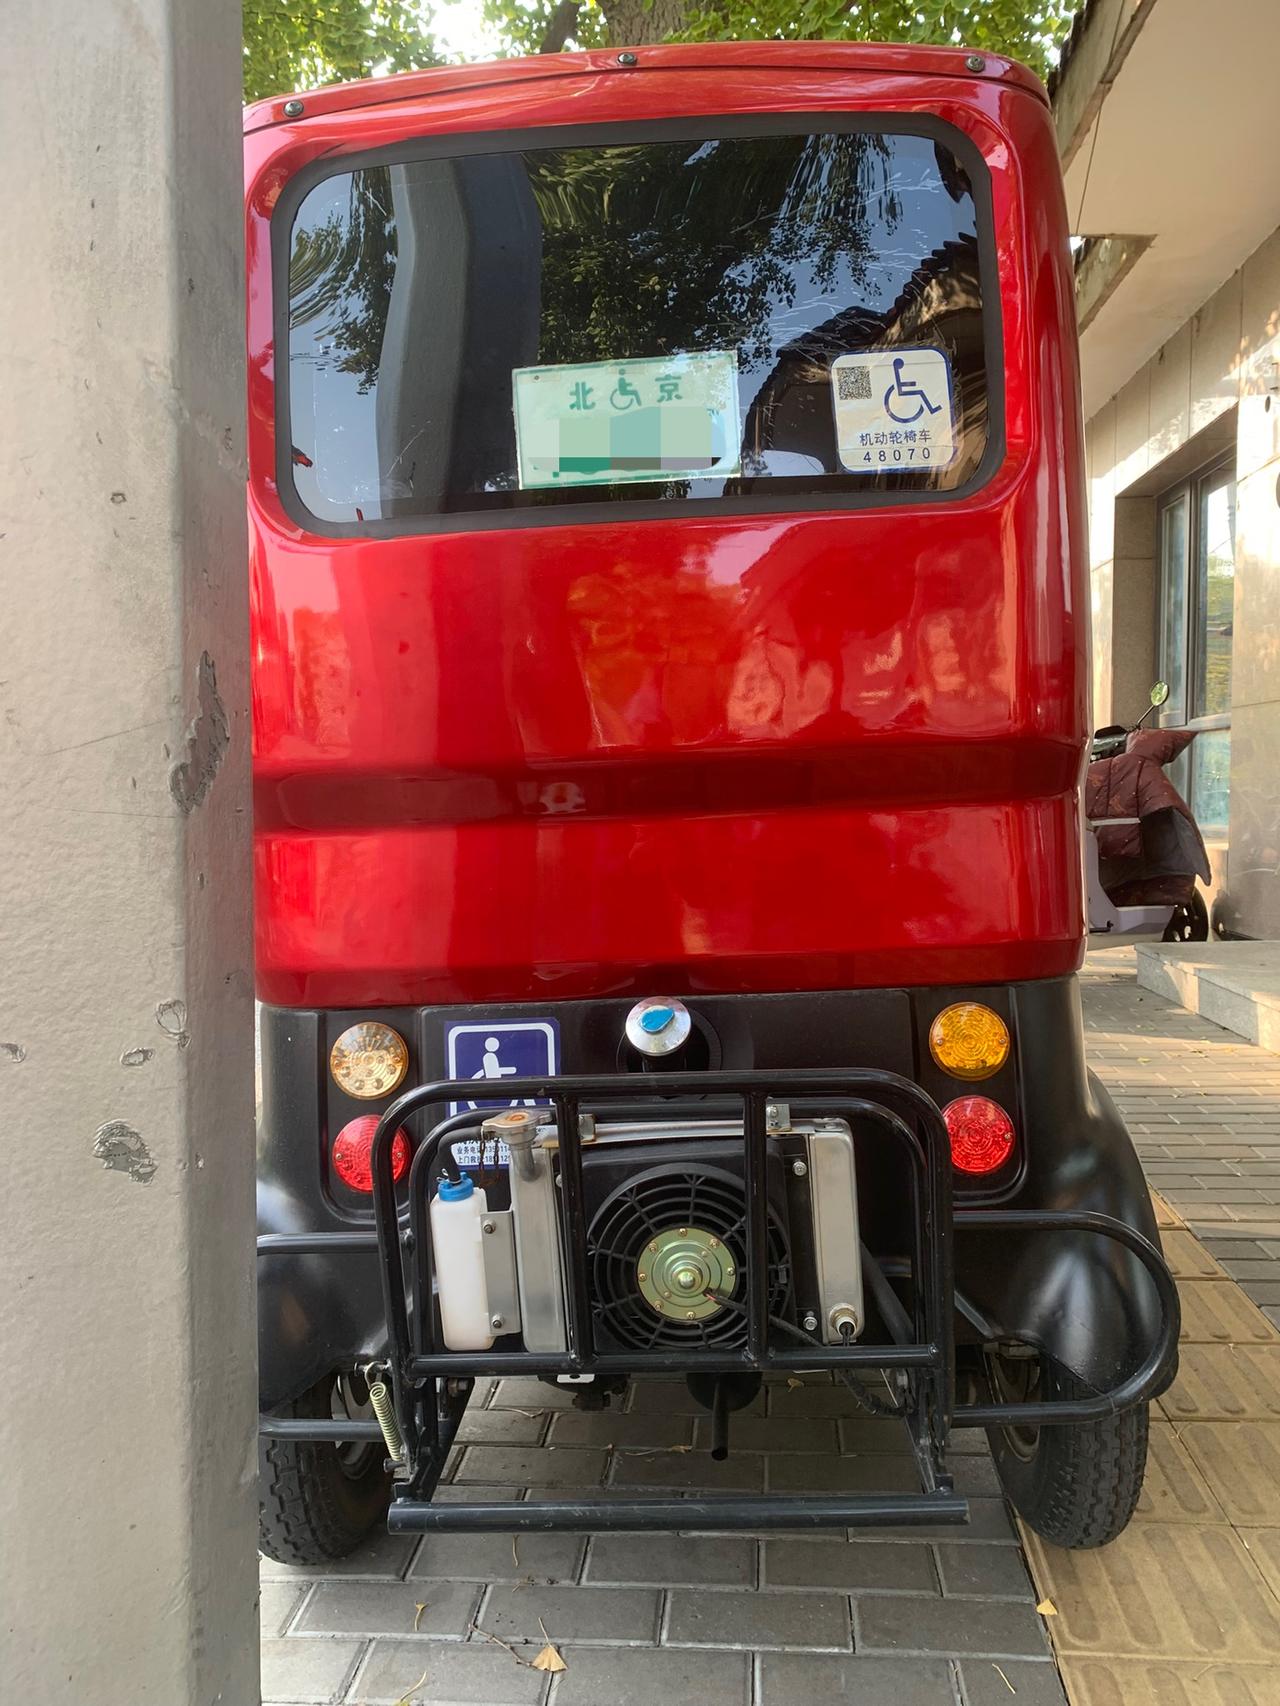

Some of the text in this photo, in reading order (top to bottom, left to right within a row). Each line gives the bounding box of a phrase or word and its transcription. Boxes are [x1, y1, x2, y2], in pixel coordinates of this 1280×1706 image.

[568, 374, 683, 411] 北京
[859, 428, 932, 447] 机动轮椅车
[863, 447, 931, 463] 48070
